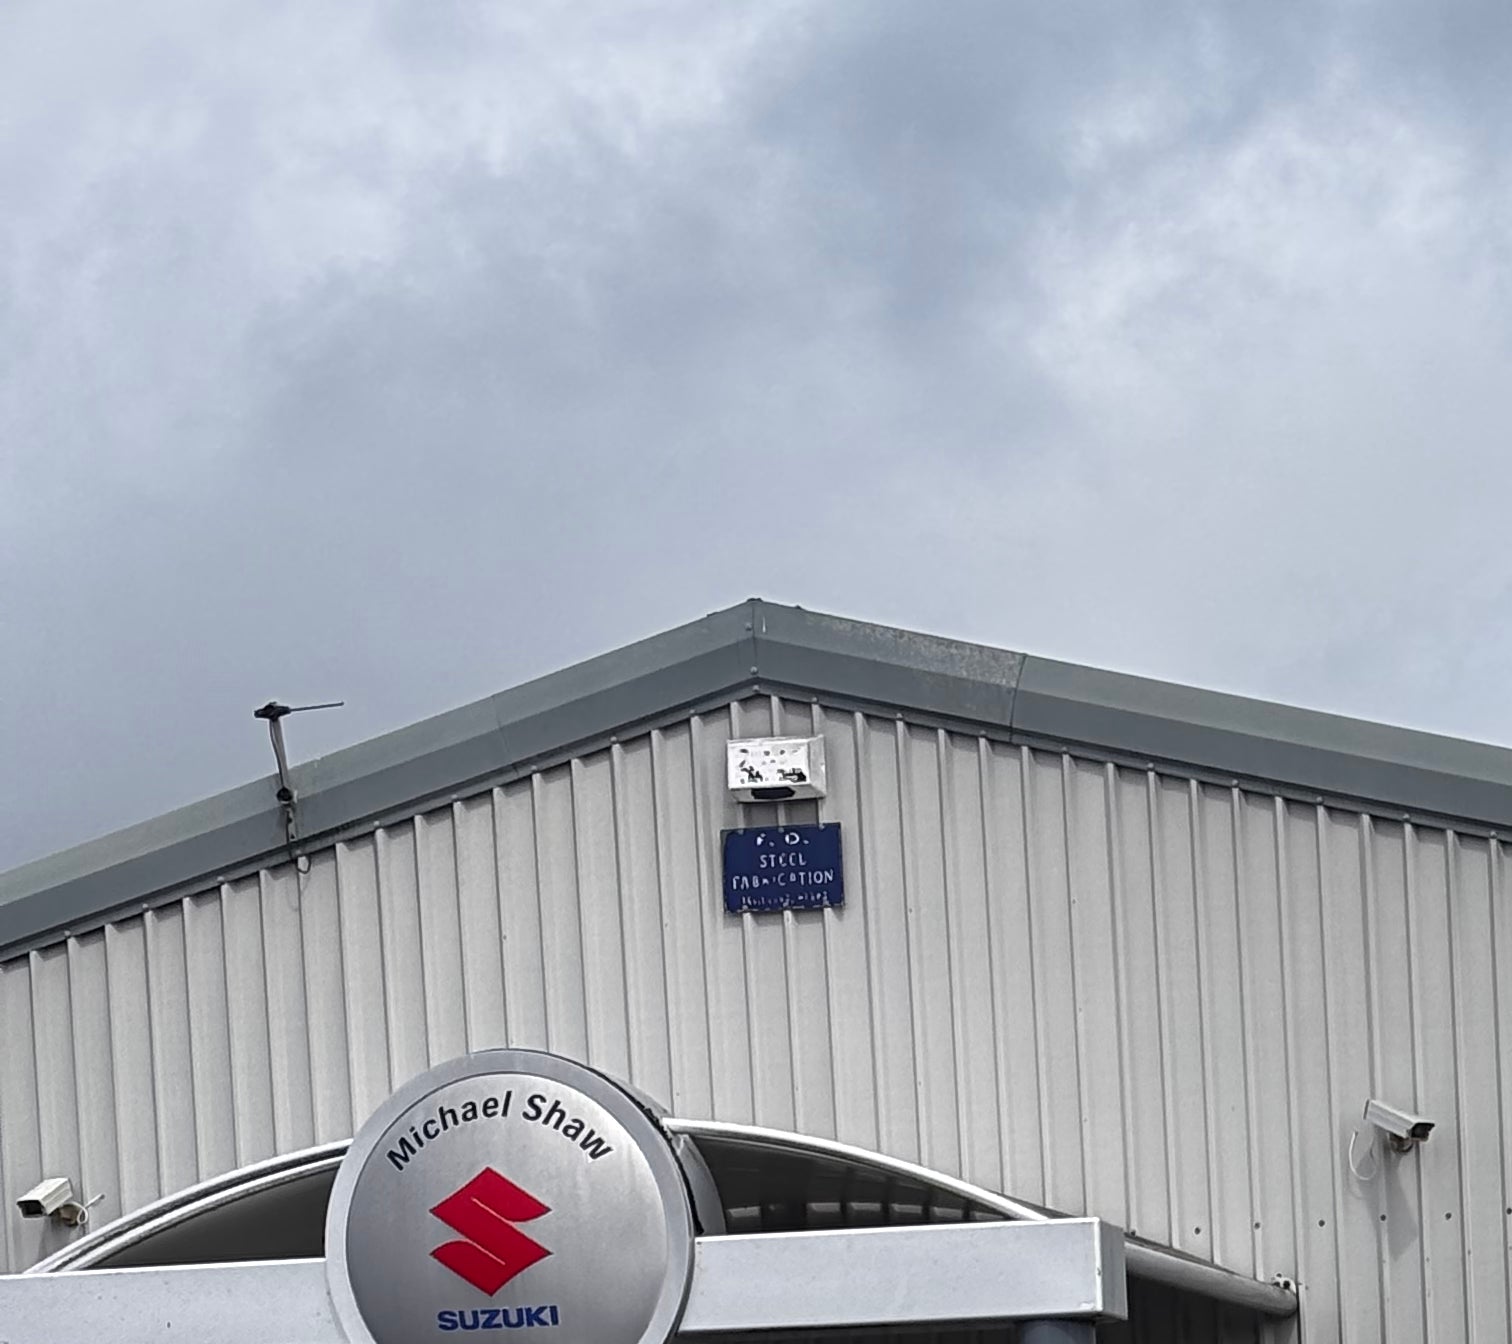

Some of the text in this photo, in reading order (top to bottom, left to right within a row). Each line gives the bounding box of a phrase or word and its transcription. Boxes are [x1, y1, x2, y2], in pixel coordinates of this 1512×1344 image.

[385, 1090, 615, 1172] Michael Shaw
[437, 1304, 559, 1331] SUZUKI
